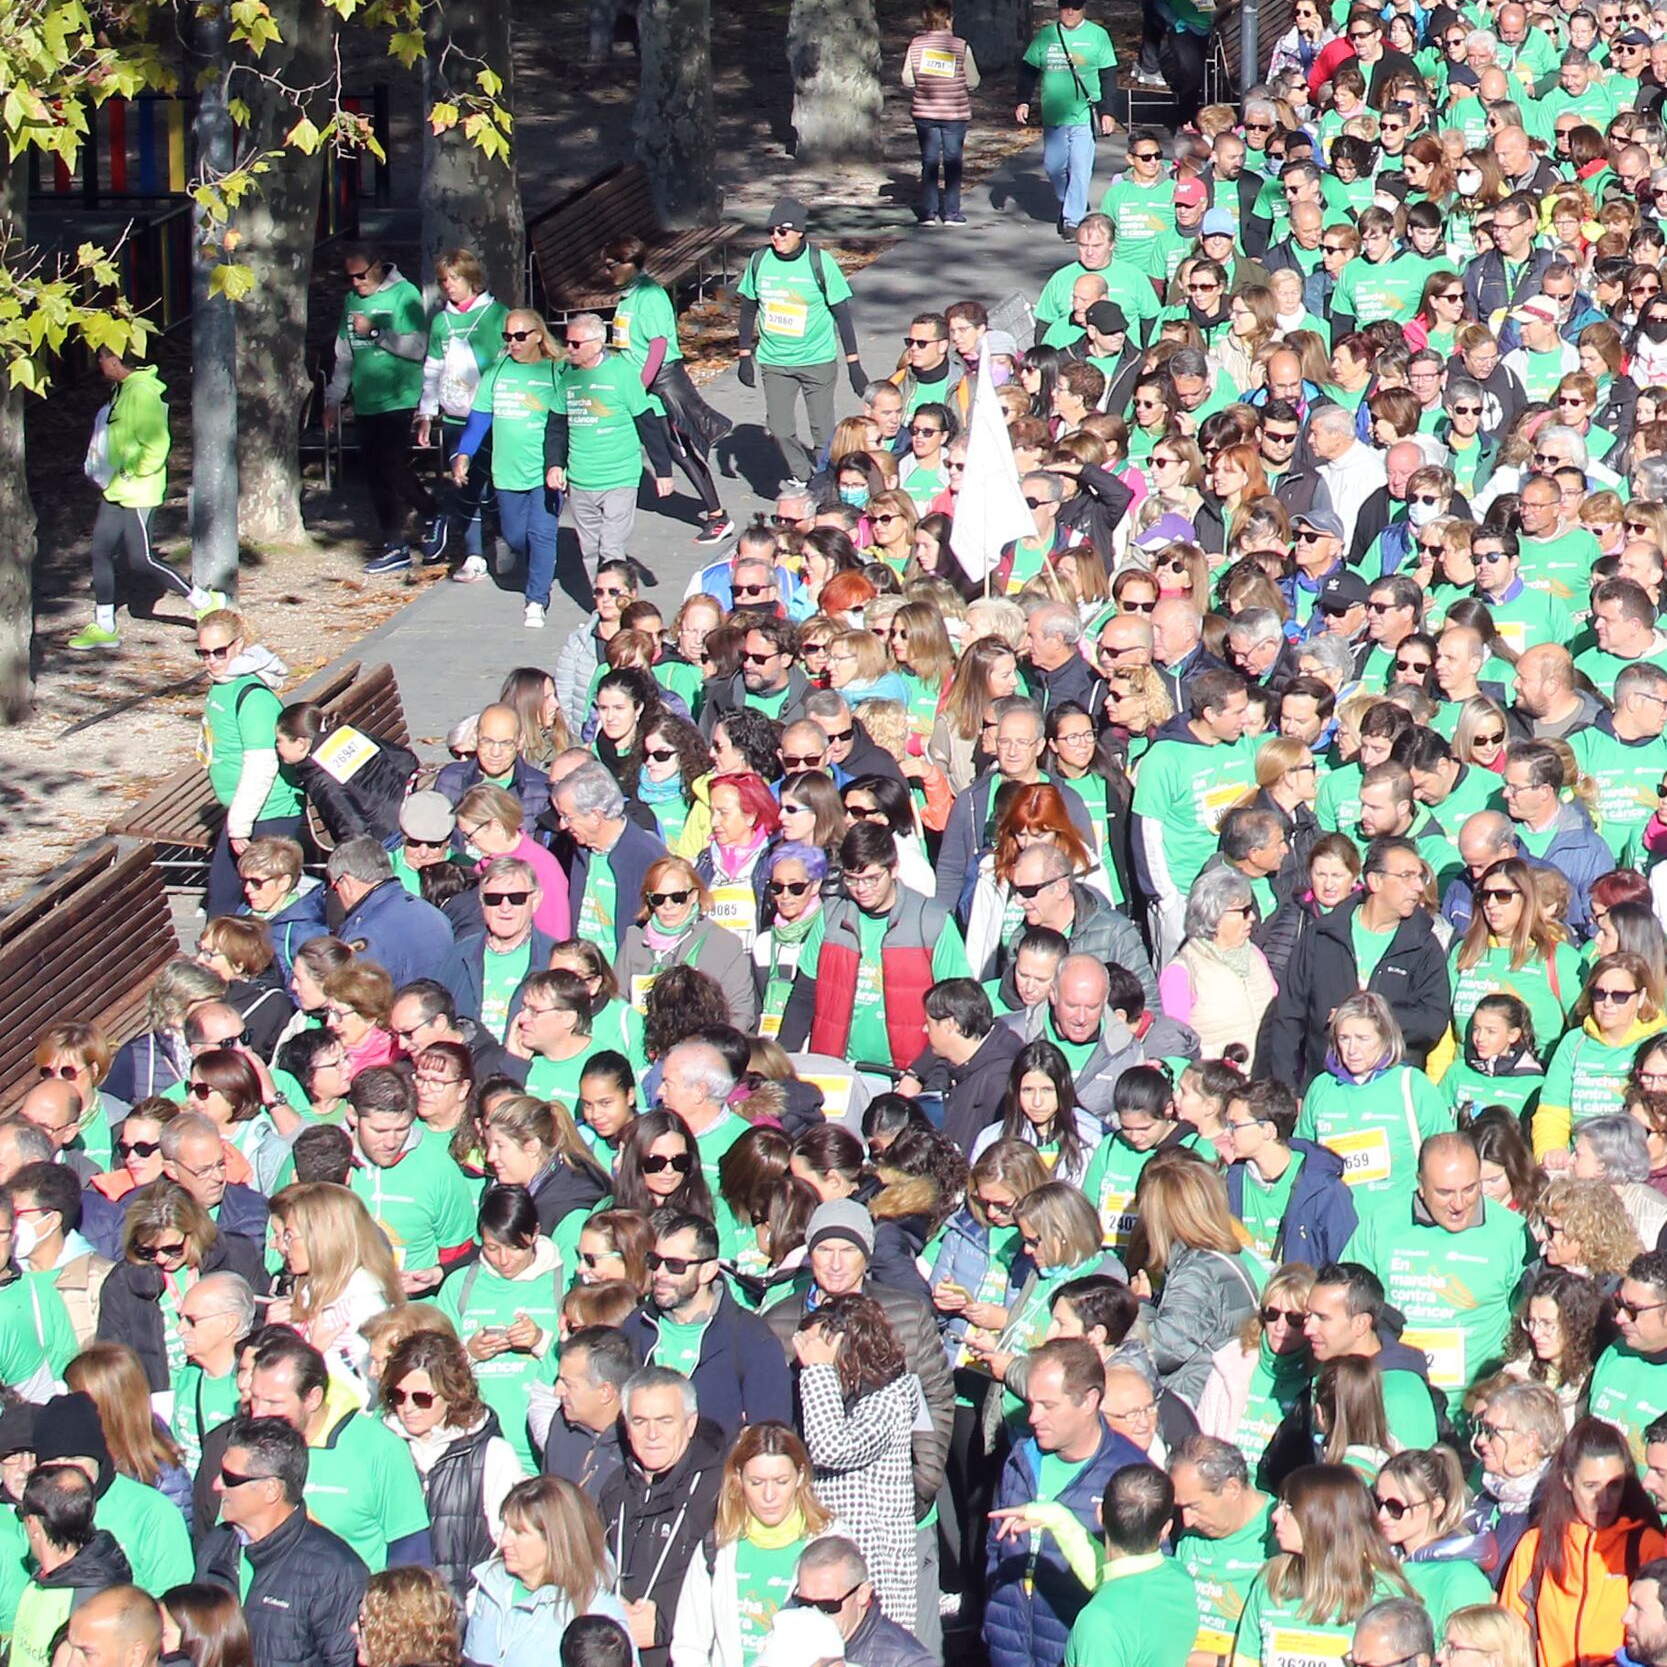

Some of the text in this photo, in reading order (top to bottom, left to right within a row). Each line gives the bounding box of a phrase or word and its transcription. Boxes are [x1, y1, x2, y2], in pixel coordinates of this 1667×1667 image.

[1573, 1077, 1620, 1089] marcha
[1343, 1152, 1371, 1171] 659
[1390, 1257, 1410, 1271] En
[1390, 1274, 1447, 1289] marcha
[1390, 1288, 1437, 1303] contra
